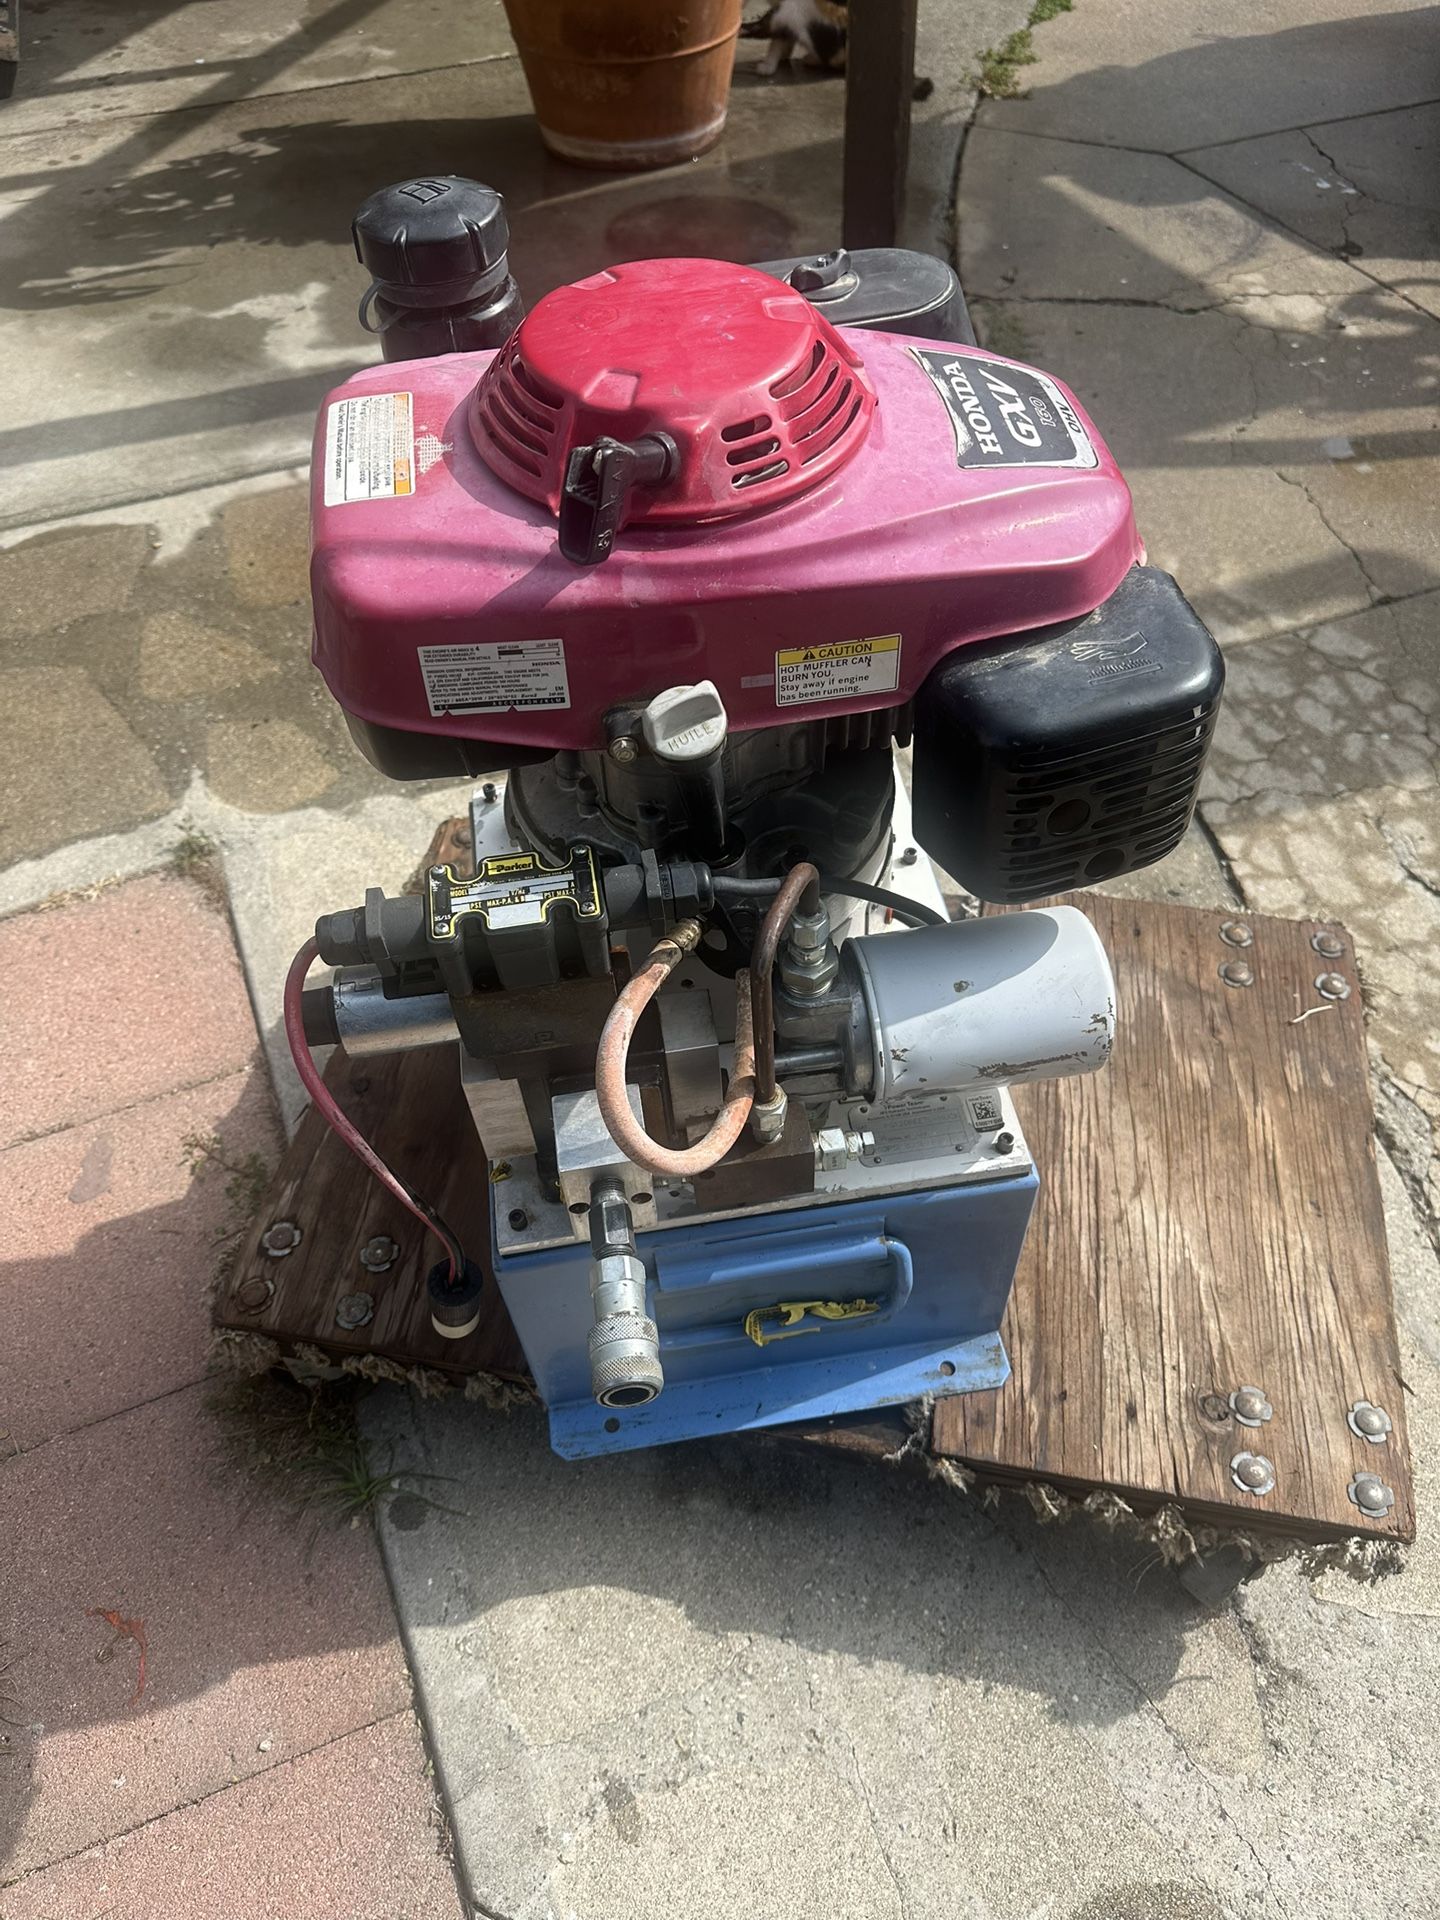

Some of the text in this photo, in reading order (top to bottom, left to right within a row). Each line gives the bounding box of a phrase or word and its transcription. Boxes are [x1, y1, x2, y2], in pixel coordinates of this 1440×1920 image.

[943, 361, 1003, 455] HONDA
[978, 368, 1042, 447] GXV
[1028, 396, 1056, 427] 160
[1056, 401, 1081, 434] OHV
[819, 643, 873, 658] CAUTION
[781, 655, 872, 674] HOT MUFFLER CAN
[780, 674, 870, 692] Stay away if engine
[781, 670, 834, 683] BURN YOU.
[780, 685, 861, 701] has been running.
[668, 721, 714, 751] HUILE
[496, 862, 532, 873] Parker
[450, 889, 468, 897] MODEL
